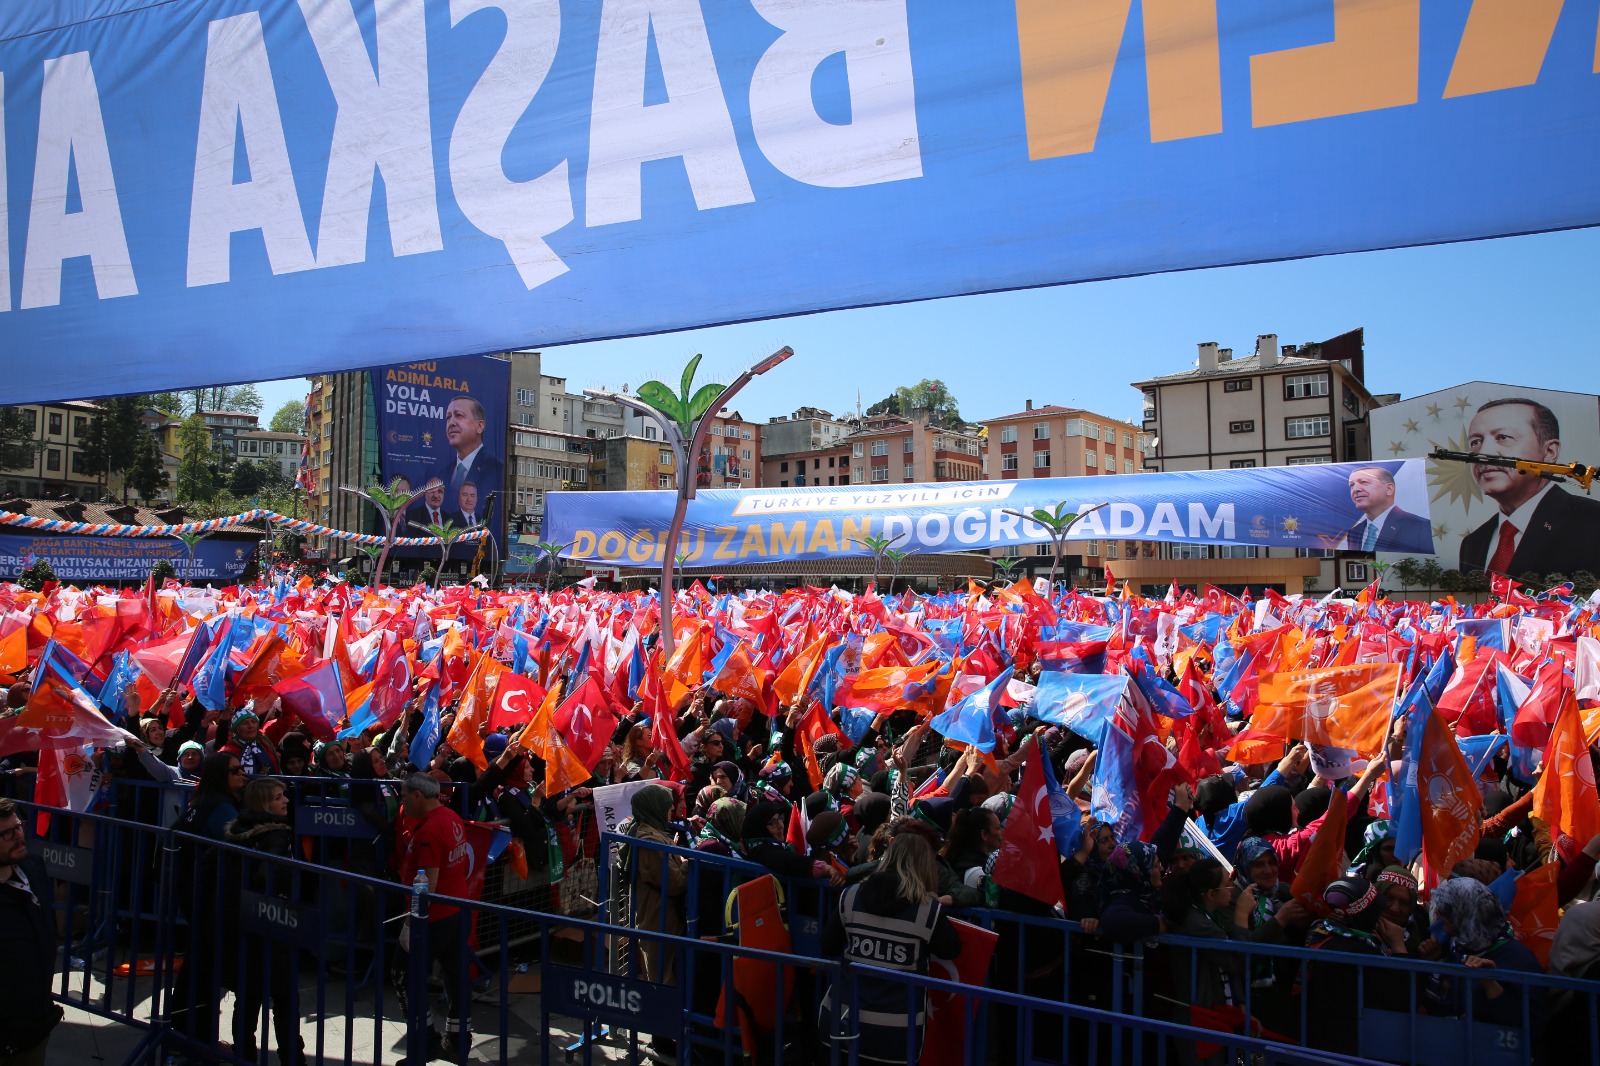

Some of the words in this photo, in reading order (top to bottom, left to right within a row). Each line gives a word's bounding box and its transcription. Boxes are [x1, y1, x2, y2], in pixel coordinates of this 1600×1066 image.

[386, 369, 470, 393] ADIMLARLA
[386, 384, 431, 403] YOLA
[386, 400, 444, 420] DEVAM
[752, 494, 840, 512] TÜRKİYE
[853, 488, 940, 506] YÜZYILI
[951, 485, 1001, 502] İÇİN
[712, 517, 873, 560] ZAMAN
[1068, 502, 1235, 540] ADAM
[19, 546, 48, 556] GÖĞE
[51, 547, 87, 556] BAKTIK
[32, 537, 61, 547] DAĞA
[63, 539, 99, 548] BAKTIK
[314, 808, 356, 828] POLİS
[603, 805, 616, 821] AK
[42, 845, 76, 869] POLİS
[257, 899, 299, 930] POLİS
[803, 918, 819, 935] 25
[850, 933, 909, 963] POLİS
[572, 978, 643, 1014] POLİS
[1496, 1029, 1520, 1049] 25
